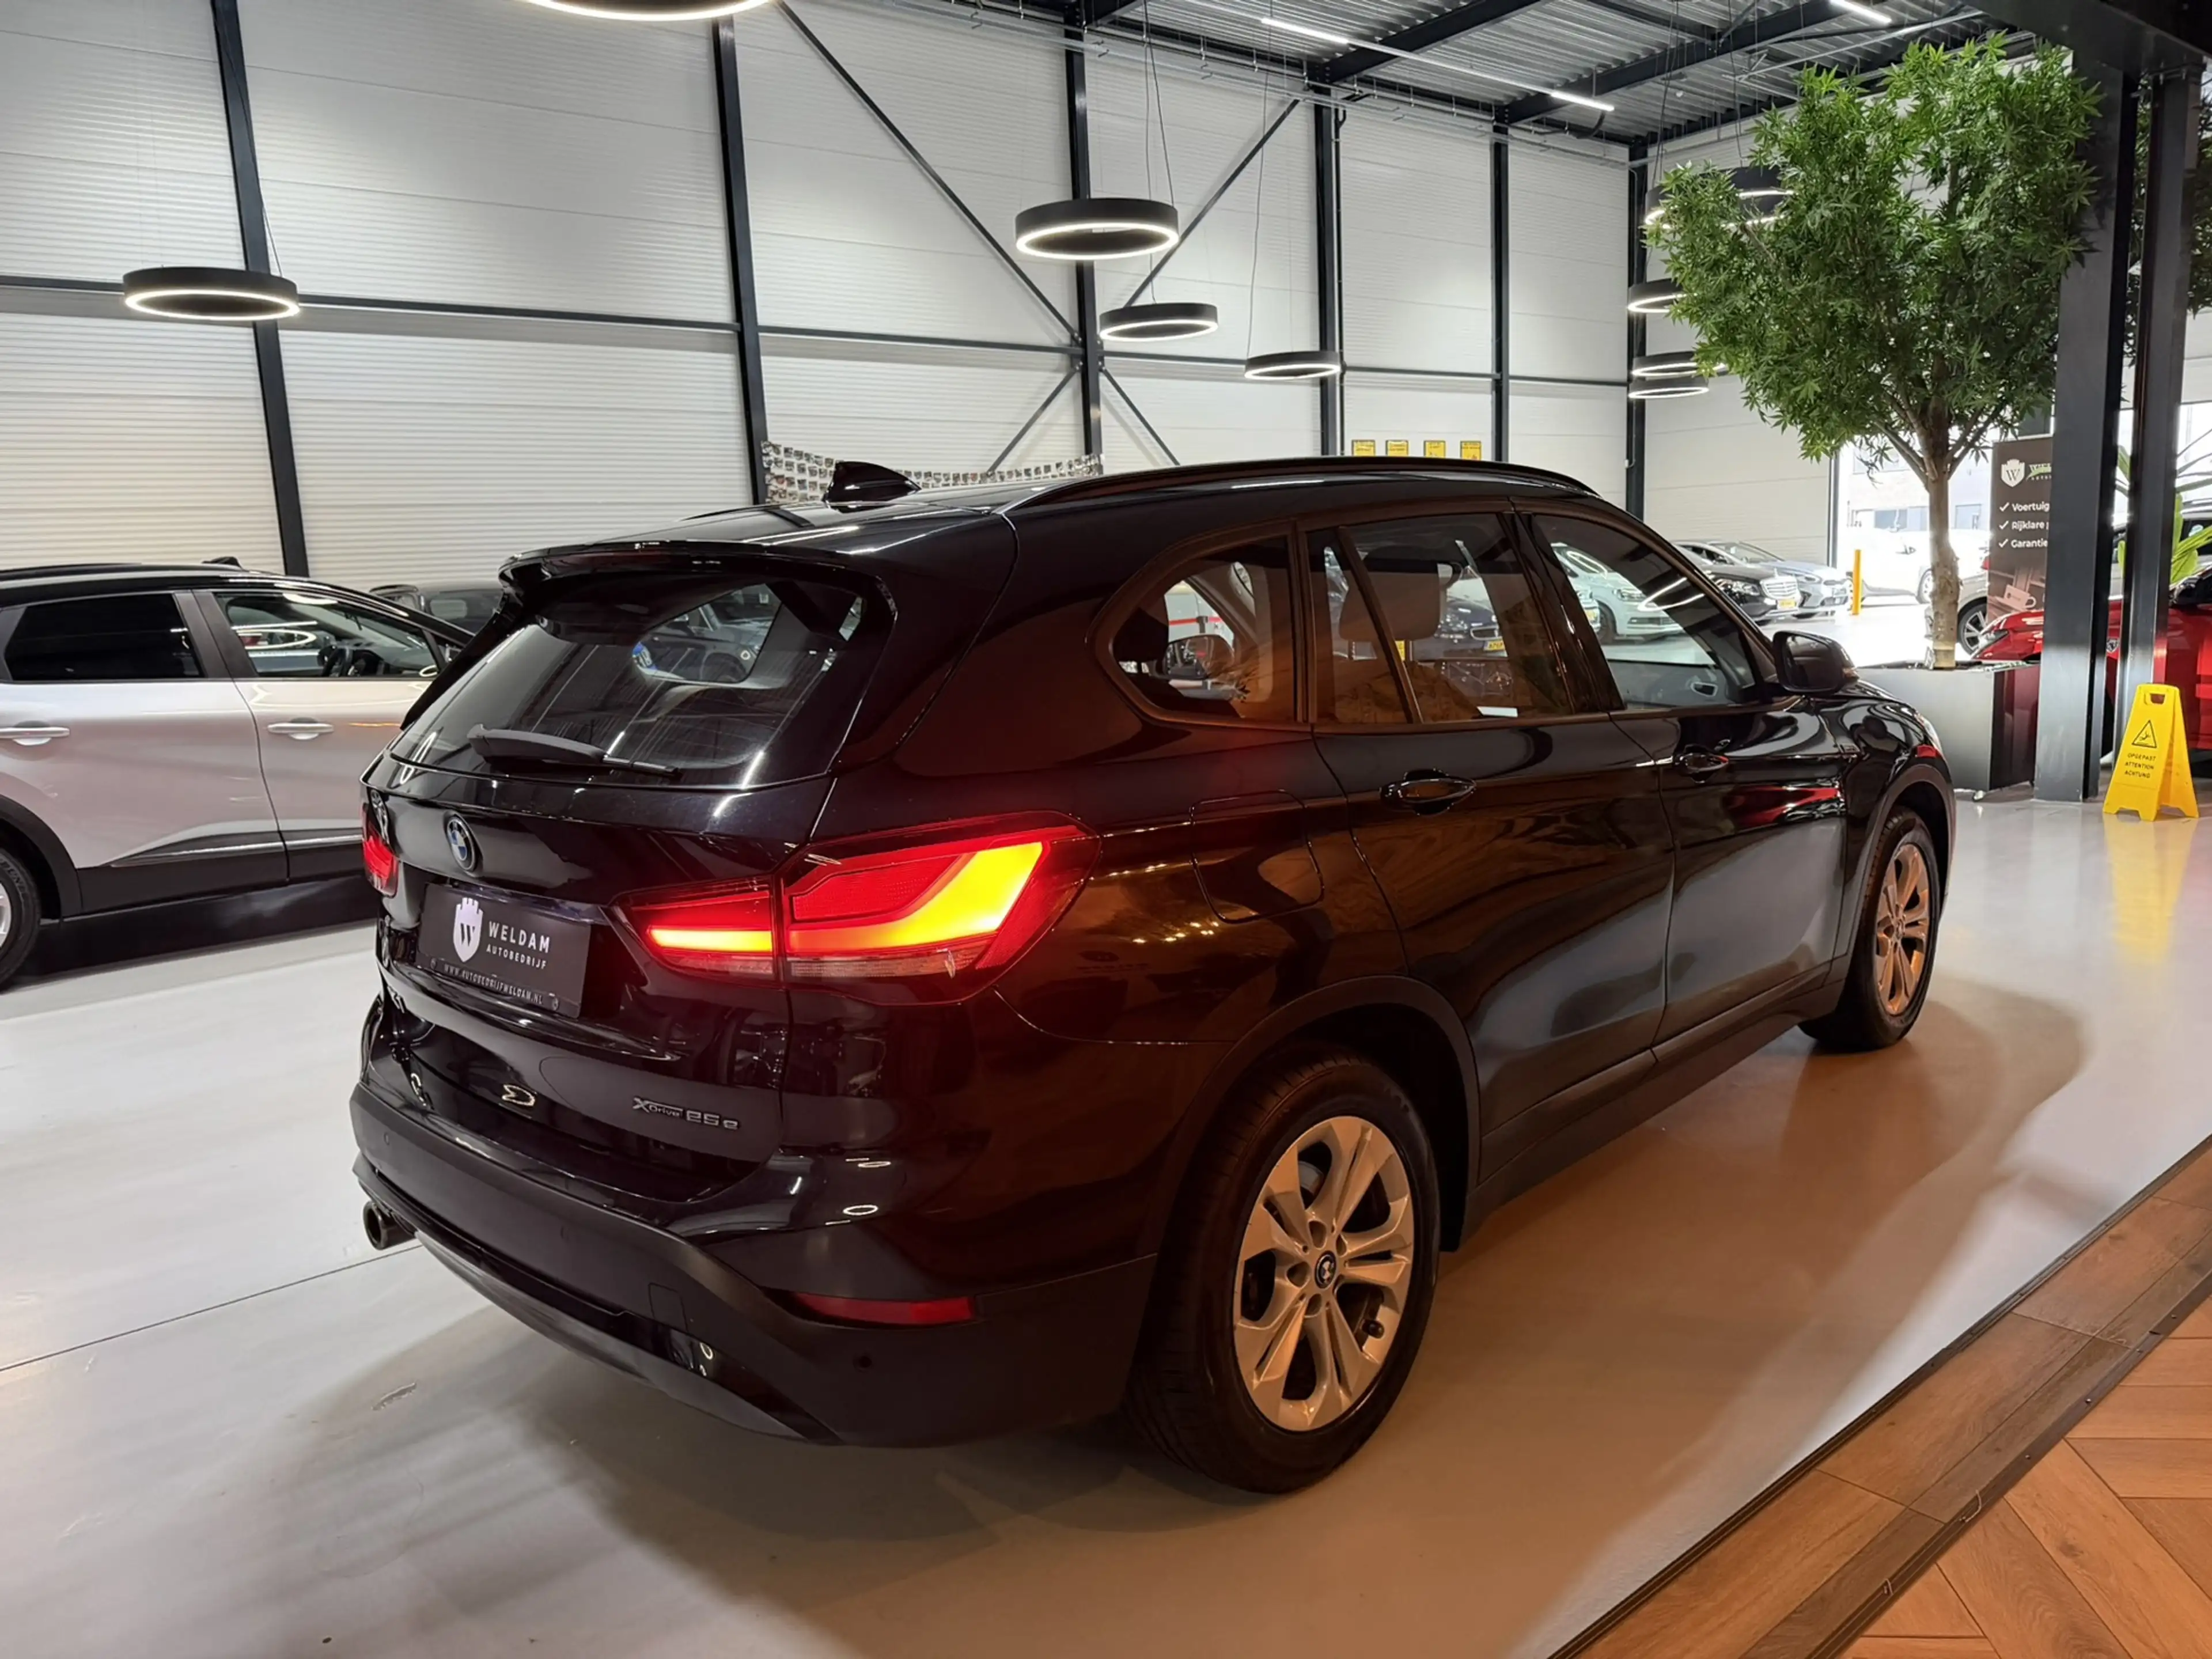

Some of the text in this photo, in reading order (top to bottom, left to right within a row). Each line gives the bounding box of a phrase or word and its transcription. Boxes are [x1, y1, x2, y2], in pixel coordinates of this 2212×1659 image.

[2006, 469, 2020, 481] W
[2012, 502, 2050, 512] Voertuig
[2012, 521, 2045, 531] Rijklare
[2011, 538, 2048, 548] Garantie
[2127, 752, 2156, 761] OPGEPAST
[2124, 762, 2154, 770] ATTENTION
[2124, 770, 2150, 779] ACHTUNG
[460, 922, 476, 947] W
[489, 921, 550, 953] WELDAM
[486, 944, 547, 969] AUTOBEDRIJF
[444, 964, 543, 1005] WWW.AUTOBEDRIJFWELDAM.NL
